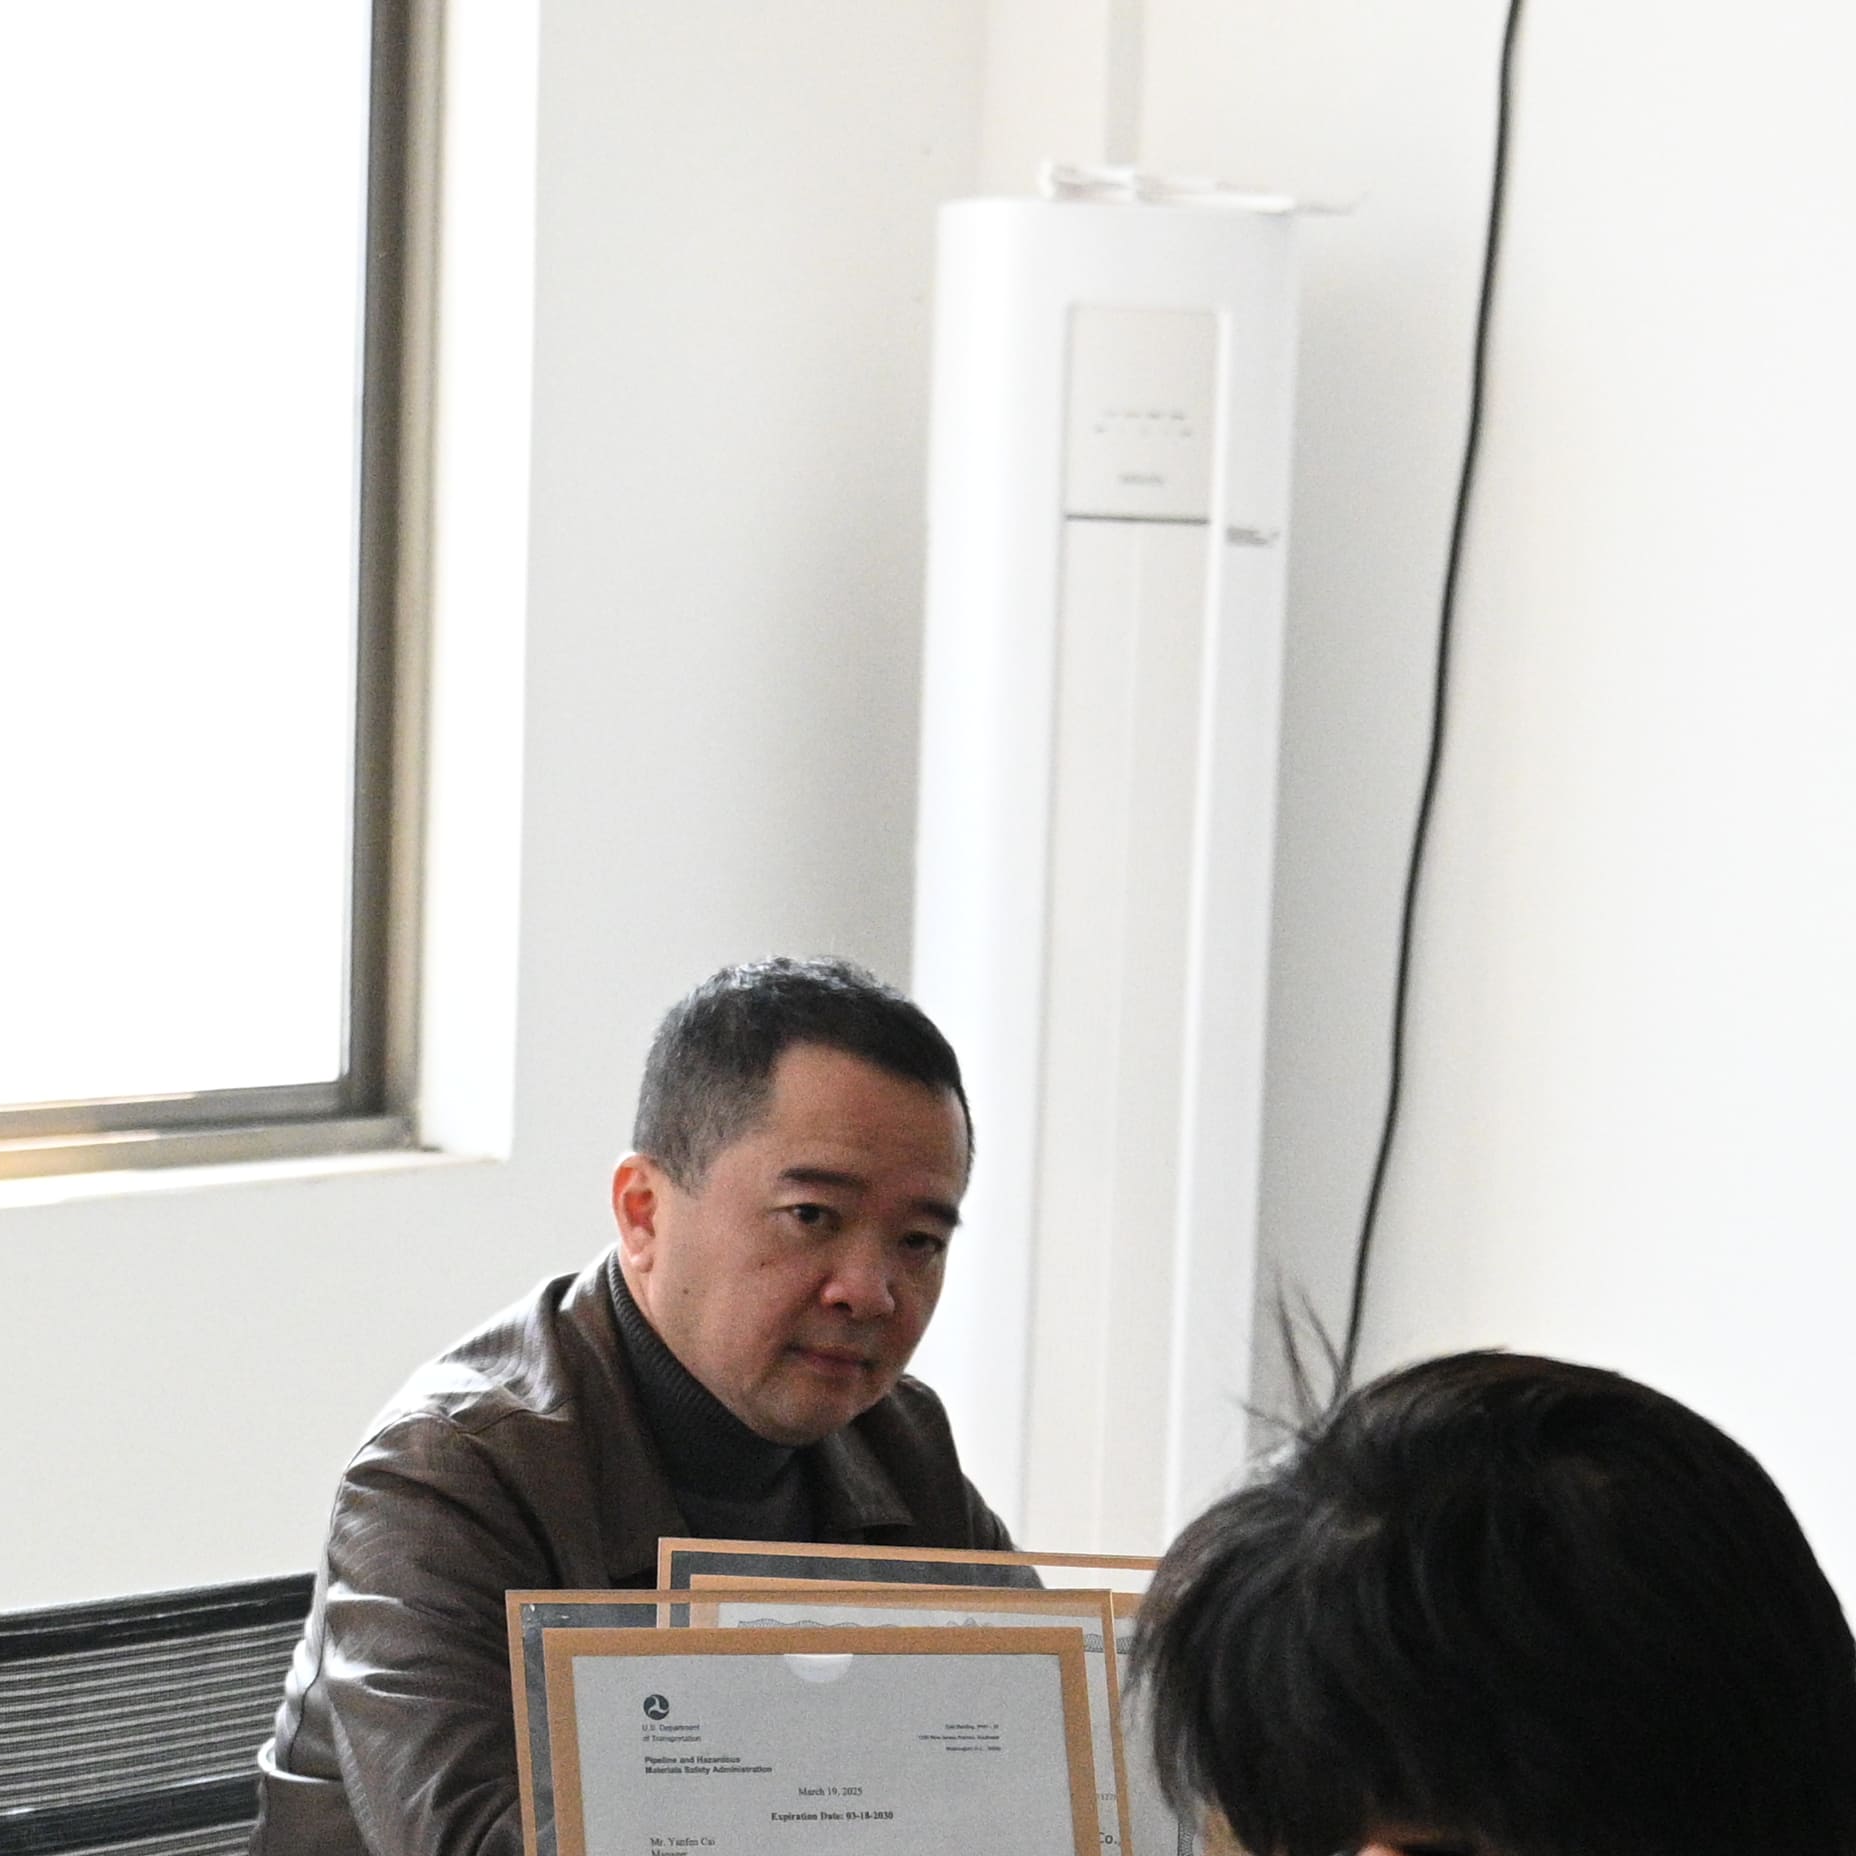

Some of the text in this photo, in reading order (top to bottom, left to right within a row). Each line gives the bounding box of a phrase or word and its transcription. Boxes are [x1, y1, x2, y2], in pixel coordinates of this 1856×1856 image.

[797, 1786, 825, 1795] March
[841, 1786, 863, 1795] 2025
[770, 1811, 818, 1822] Expiration
[845, 1810, 894, 1819] 03-18-2030
